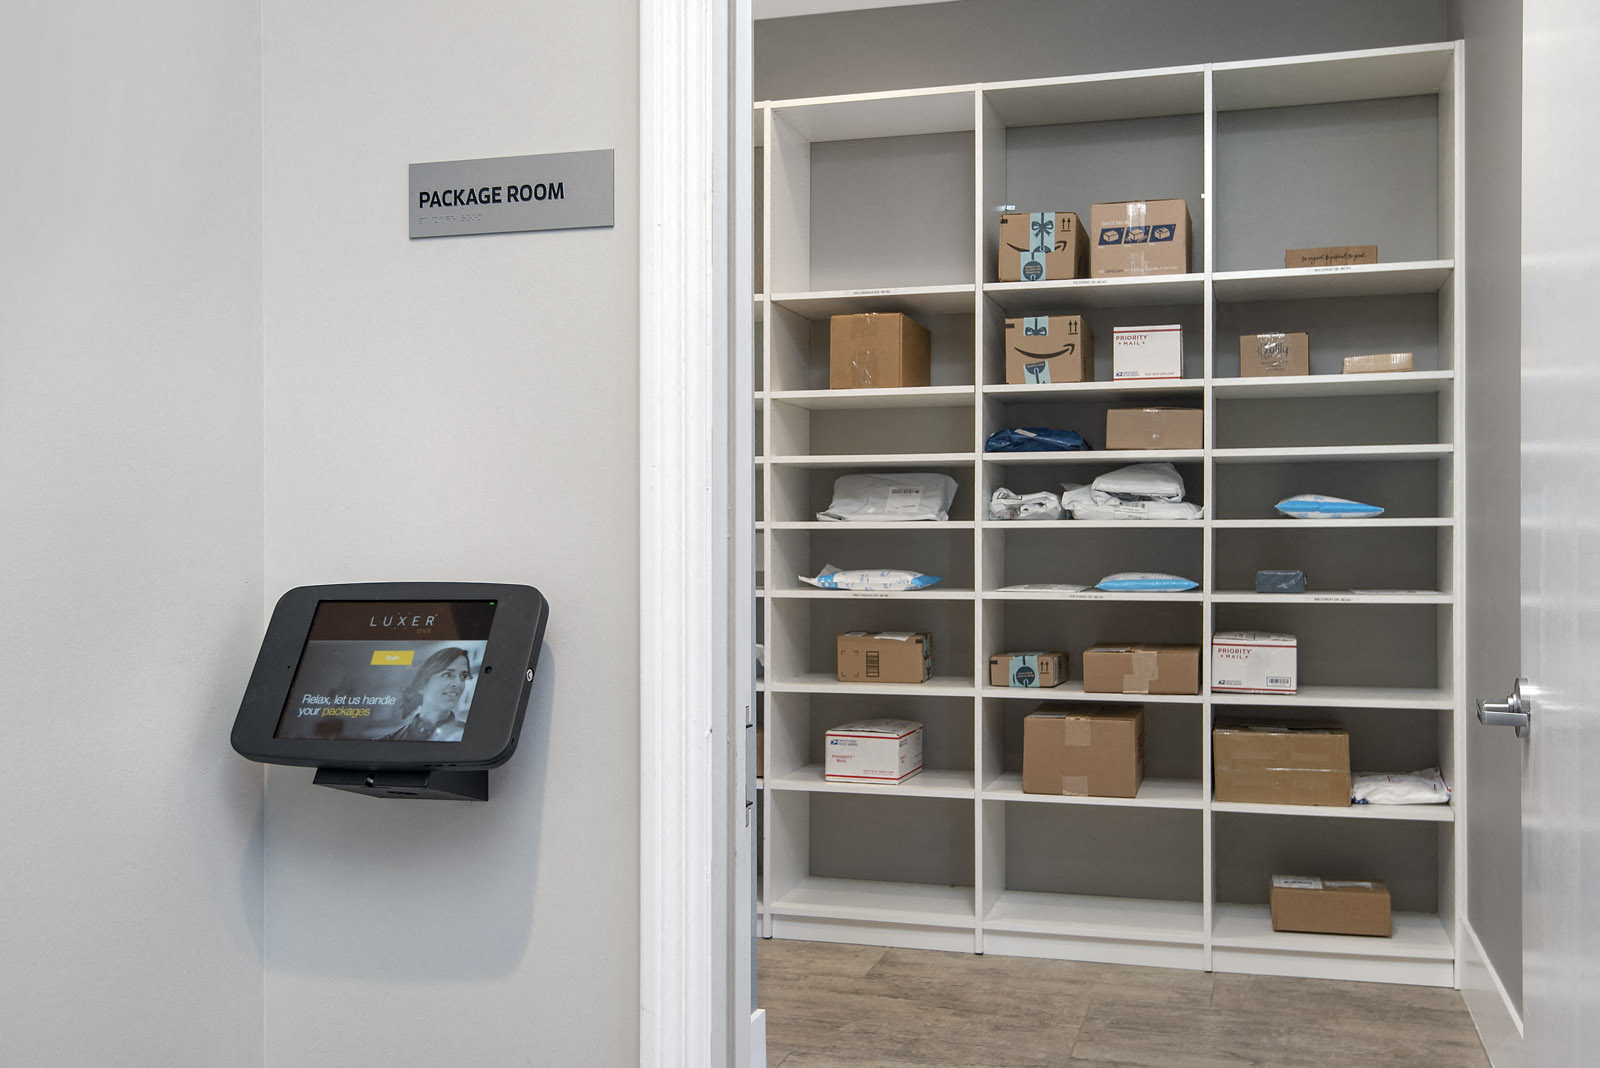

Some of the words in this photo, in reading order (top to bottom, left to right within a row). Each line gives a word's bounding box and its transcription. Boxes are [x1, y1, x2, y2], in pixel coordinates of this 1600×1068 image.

[419, 187, 502, 208] PACKAGE
[507, 182, 565, 203] ROOM
[369, 615, 435, 627] LUXER
[302, 694, 331, 705] Relax,
[334, 694, 346, 704] let
[348, 696, 360, 705] us
[362, 694, 396, 705] handle
[297, 707, 321, 718] your
[321, 706, 371, 718] packages
